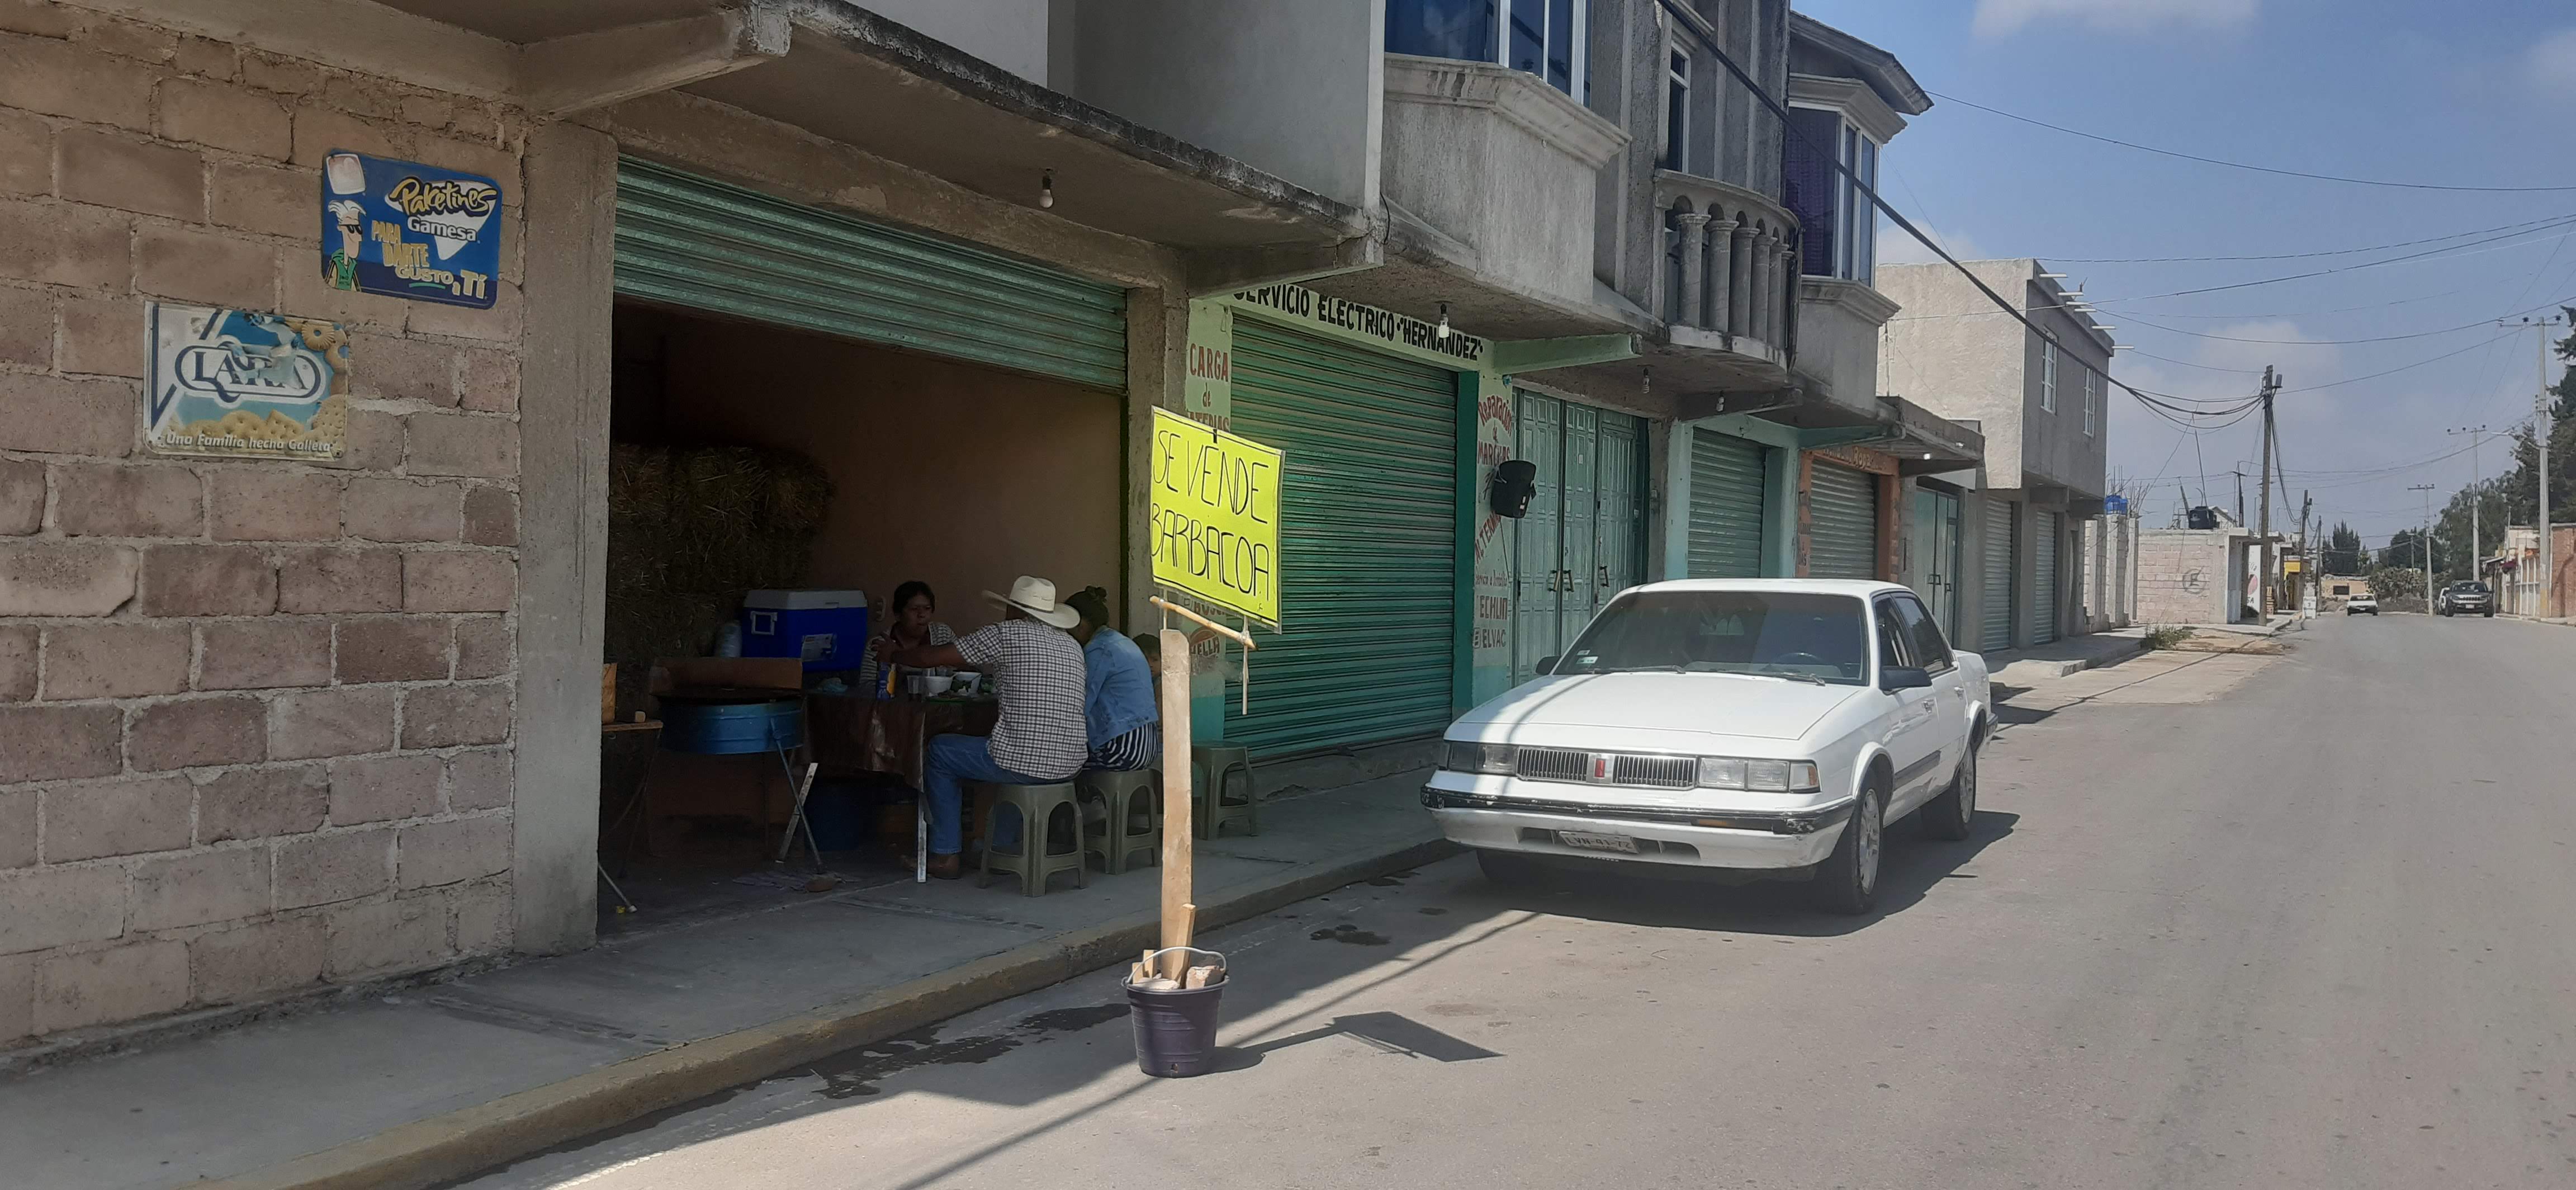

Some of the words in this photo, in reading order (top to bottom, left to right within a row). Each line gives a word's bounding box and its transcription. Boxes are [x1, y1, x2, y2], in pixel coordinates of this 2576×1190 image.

[388, 176, 498, 215] Paketines
[372, 220, 401, 244] PARA
[407, 216, 476, 241] Gamesa
[382, 243, 429, 267] DARTE
[1233, 284, 1310, 317] RVICIO
[1317, 294, 1394, 342] ELECTRICO
[1190, 343, 1229, 382] CARGA
[1202, 382, 1211, 407] de
[166, 432, 193, 446] Una
[197, 433, 244, 447] Familia
[248, 437, 284, 450] hecha
[1153, 429, 1181, 493] SE
[1187, 441, 1269, 525] VENDE
[1151, 503, 1270, 602] BARBACOA
[1483, 629, 1507, 649] ELVAC
